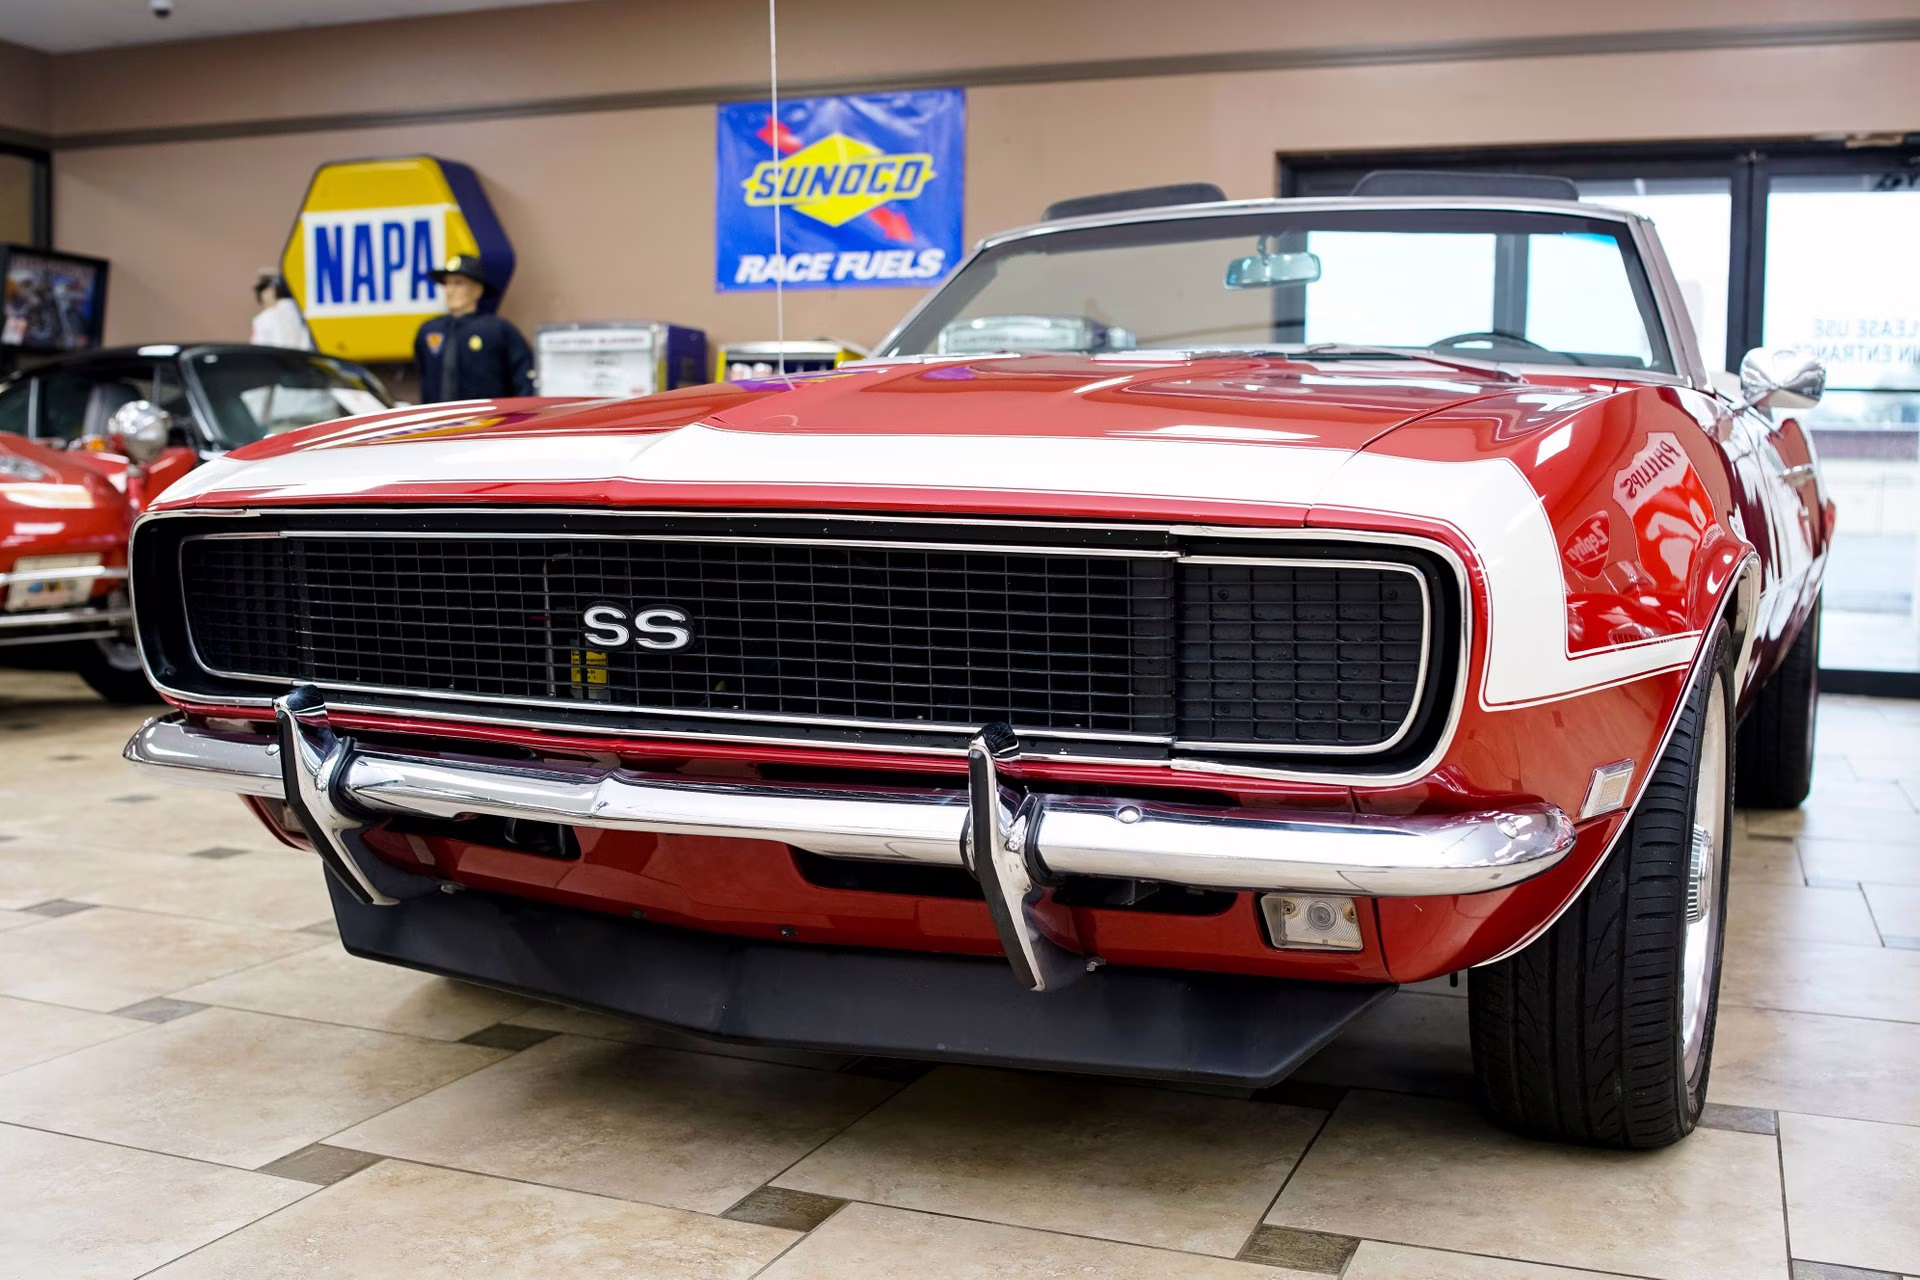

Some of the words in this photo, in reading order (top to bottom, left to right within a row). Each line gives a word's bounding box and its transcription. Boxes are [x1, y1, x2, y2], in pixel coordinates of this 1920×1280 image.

[752, 160, 927, 199] SUNOCO
[314, 217, 437, 305] NAPA
[735, 254, 835, 284] RACE
[833, 248, 946, 281] FUELS
[583, 605, 691, 650] SS
